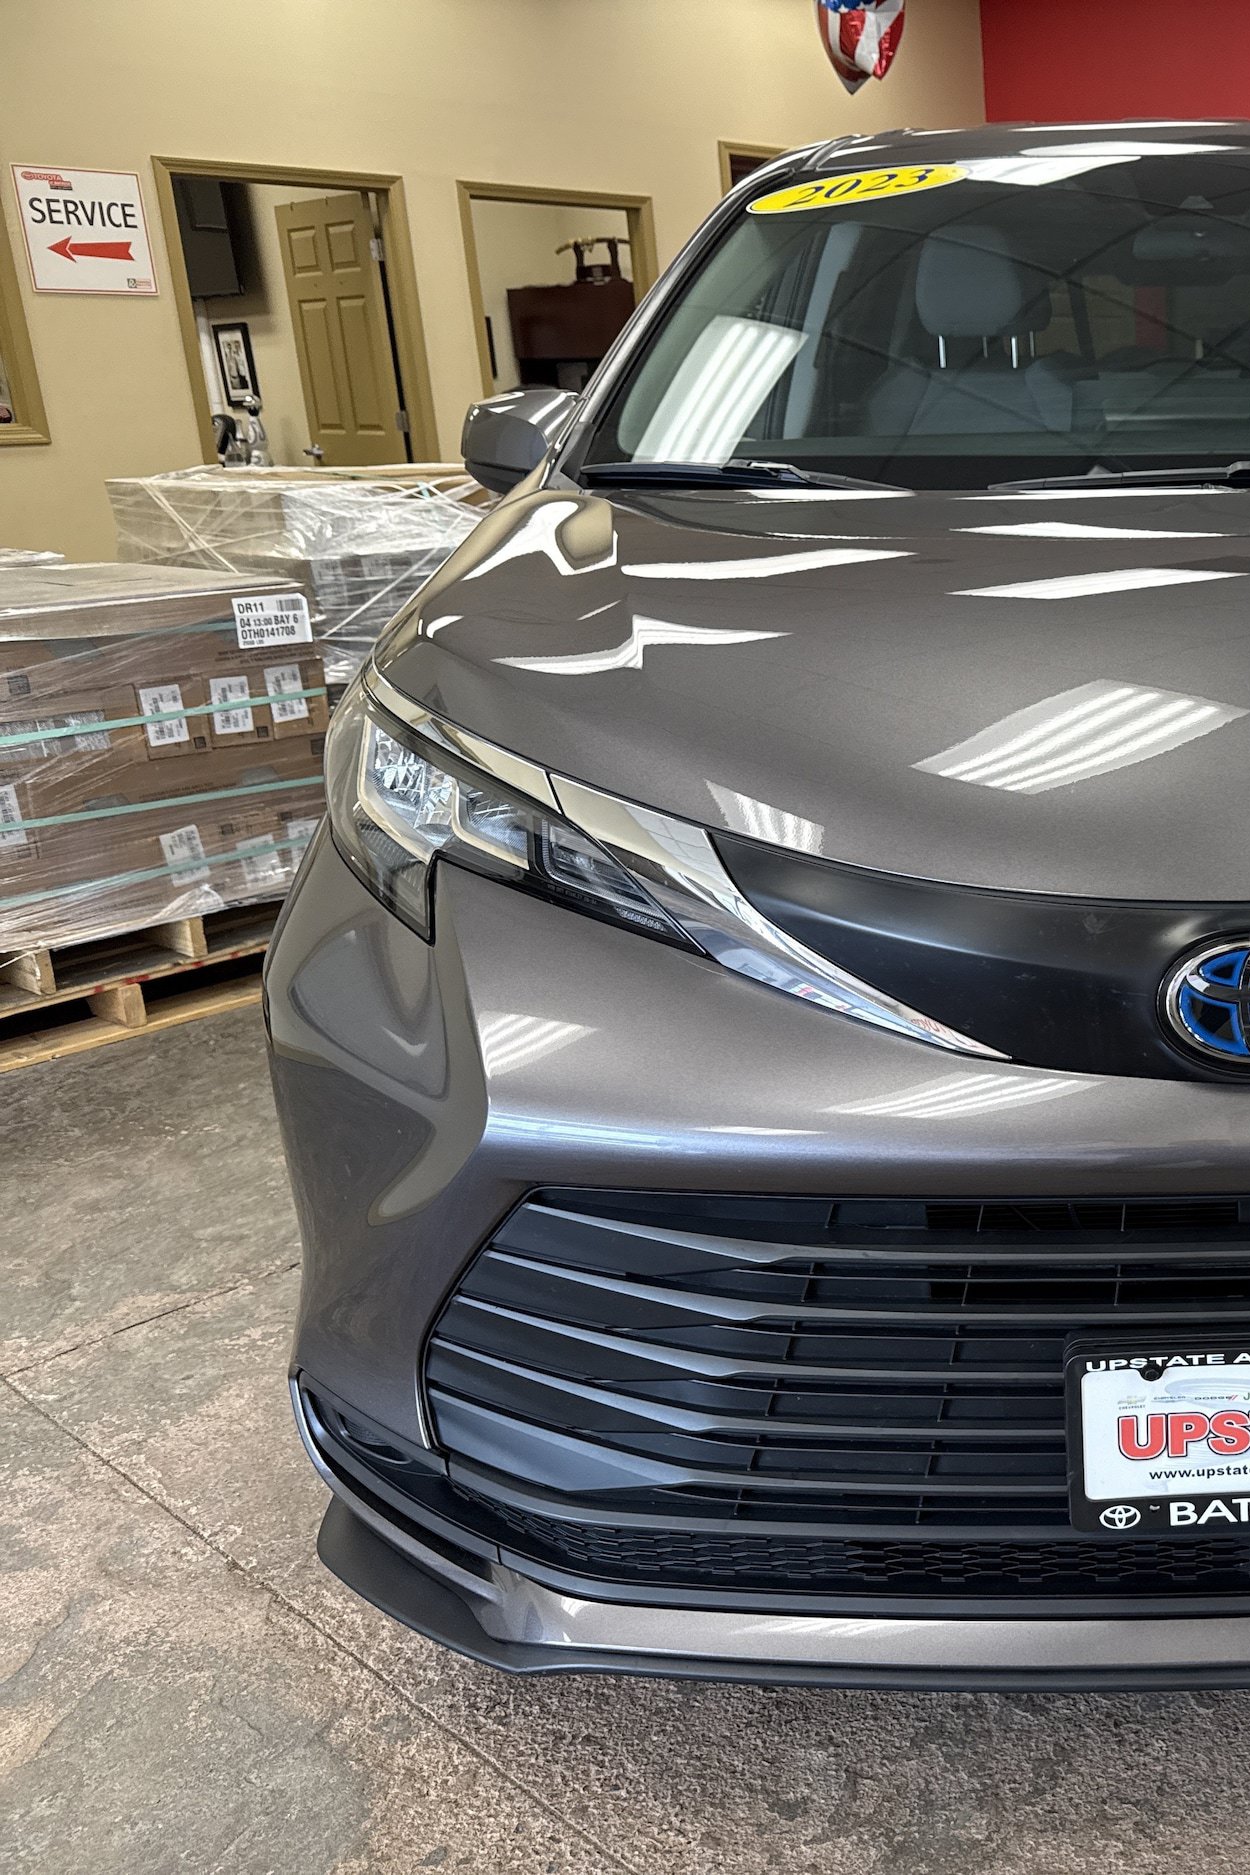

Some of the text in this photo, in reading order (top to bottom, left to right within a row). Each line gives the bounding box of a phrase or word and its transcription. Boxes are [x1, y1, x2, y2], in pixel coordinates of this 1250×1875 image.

[783, 168, 935, 208] 2023
[29, 197, 138, 228] SERVICE
[237, 602, 264, 614] DR11
[240, 617, 251, 628] 04
[273, 614, 291, 625] BAY
[292, 613, 299, 623] 6
[1086, 1353, 1226, 1372] UPSTATE
